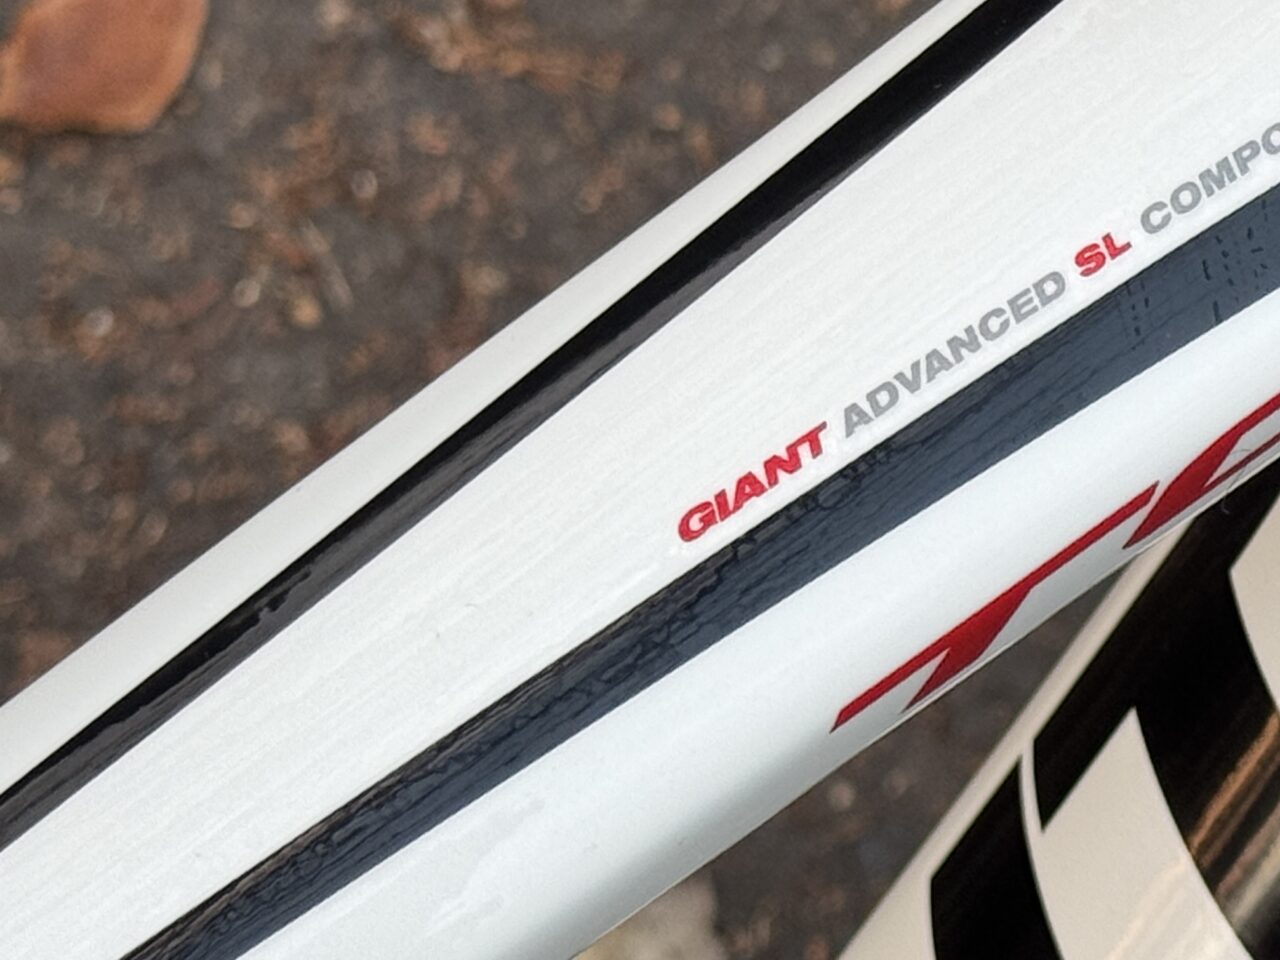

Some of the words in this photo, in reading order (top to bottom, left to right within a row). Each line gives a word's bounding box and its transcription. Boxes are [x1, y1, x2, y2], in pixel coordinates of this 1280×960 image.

[677, 420, 828, 543] GIANT
[841, 270, 1067, 437] ADVANCED
[1073, 232, 1133, 278] SL
